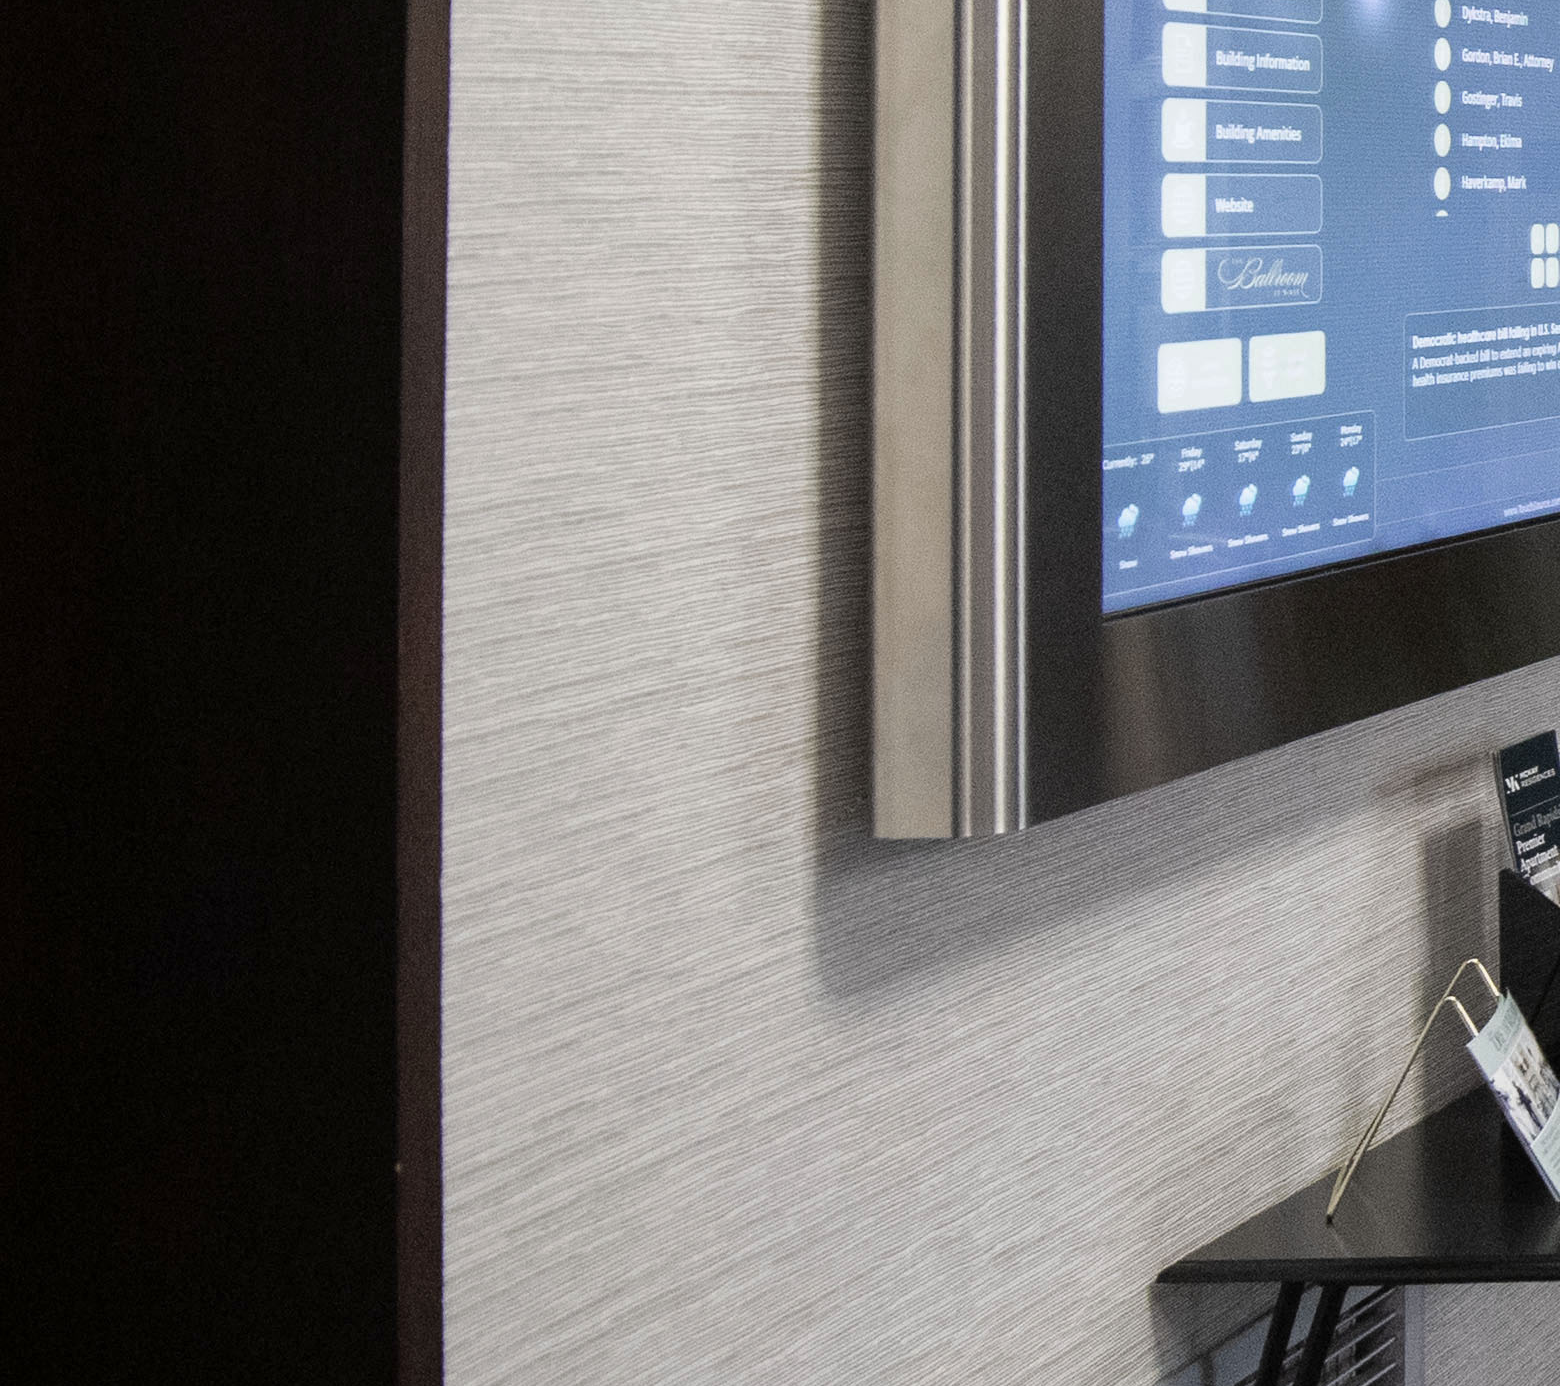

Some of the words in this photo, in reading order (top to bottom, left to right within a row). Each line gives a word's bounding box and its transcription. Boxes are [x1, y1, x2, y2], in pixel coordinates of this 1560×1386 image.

[1462, 6, 1492, 24] Dykstra,
[1494, 10, 1528, 28] Benjamin
[1216, 50, 1255, 71] Building
[1256, 53, 1310, 70] Information
[1462, 48, 1492, 65] Gordon,
[1492, 51, 1512, 65] Brian
[1523, 54, 1554, 72] Attorney
[1500, 93, 1522, 107] Travis
[1216, 124, 1255, 143] Building
[1256, 127, 1301, 141] Amenities
[1462, 134, 1498, 150] Hampton,
[1462, 176, 1506, 192] Haverkamp,
[1507, 176, 1526, 189] Mark
[1215, 198, 1254, 213] Website
[1217, 257, 1309, 298] Ballroom
[1412, 333, 1456, 349] Democratic
[1457, 330, 1496, 343] healthcare
[1497, 327, 1507, 340] bill
[1412, 358, 1418, 369] A
[1513, 818, 1537, 837] Grand
[1516, 833, 1545, 855] Premier
[1520, 845, 1559, 875] Apartment
